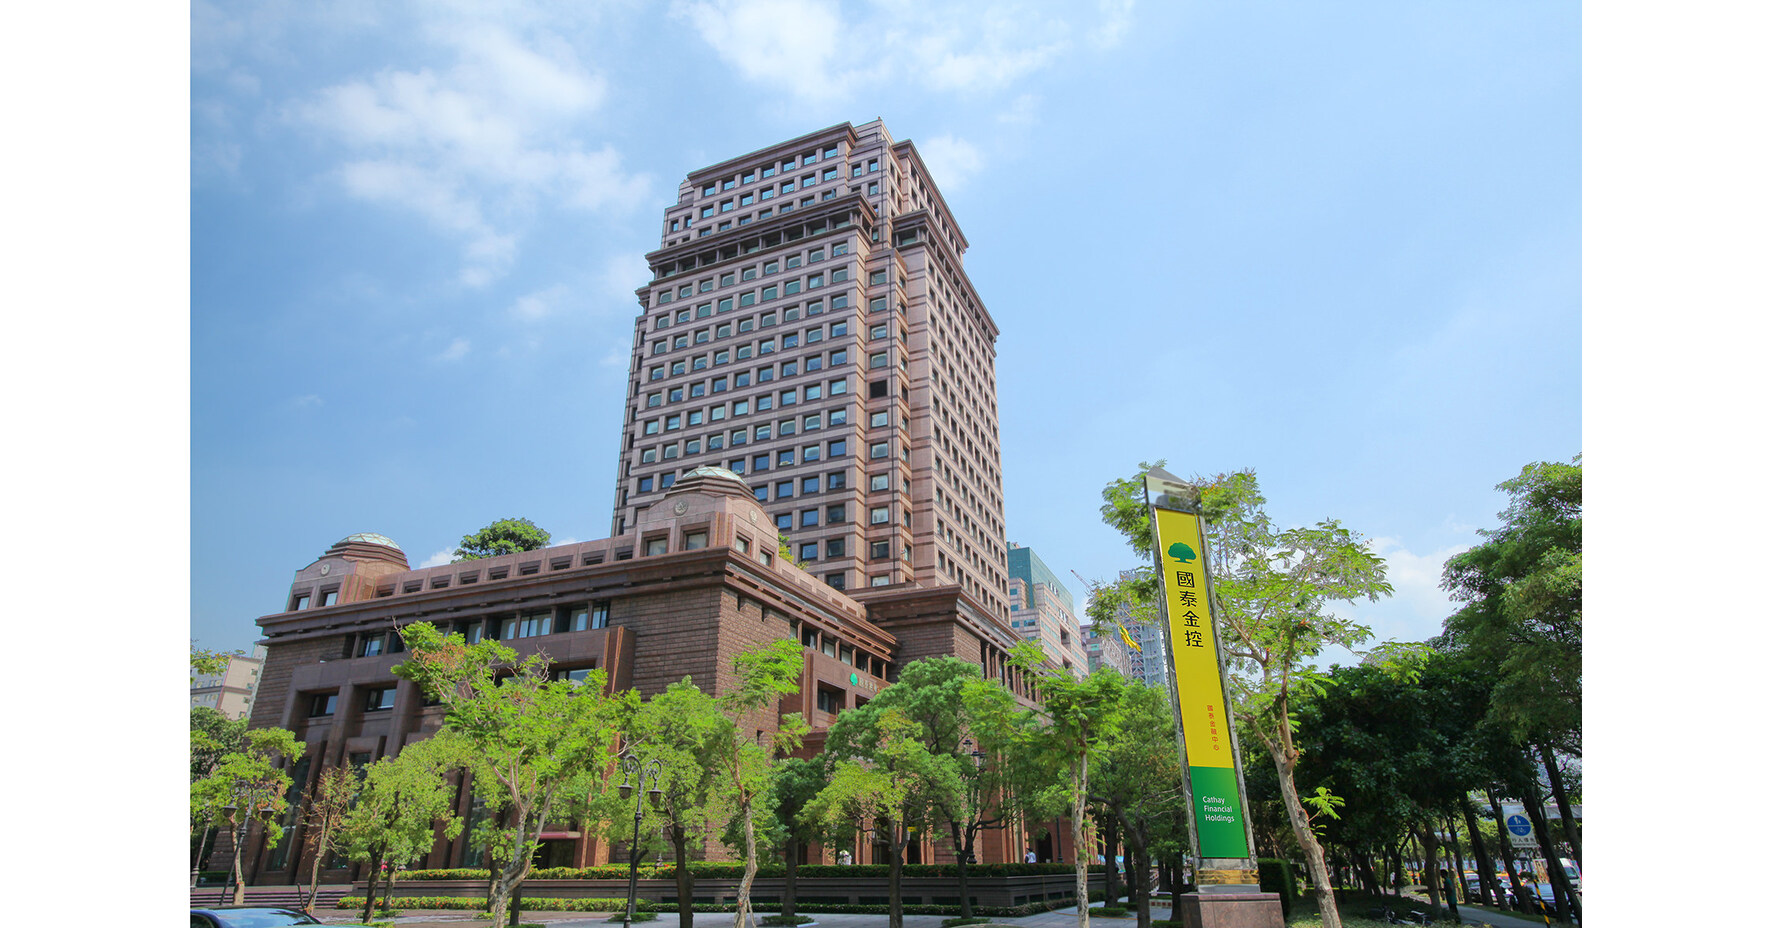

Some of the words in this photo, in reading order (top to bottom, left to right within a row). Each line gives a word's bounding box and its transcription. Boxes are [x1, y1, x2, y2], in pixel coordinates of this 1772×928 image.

[1176, 570, 1204, 648] 國泰金控
[1202, 795, 1225, 805] Cathay
[1203, 804, 1233, 813] Financial
[1204, 814, 1235, 823] Holdings
